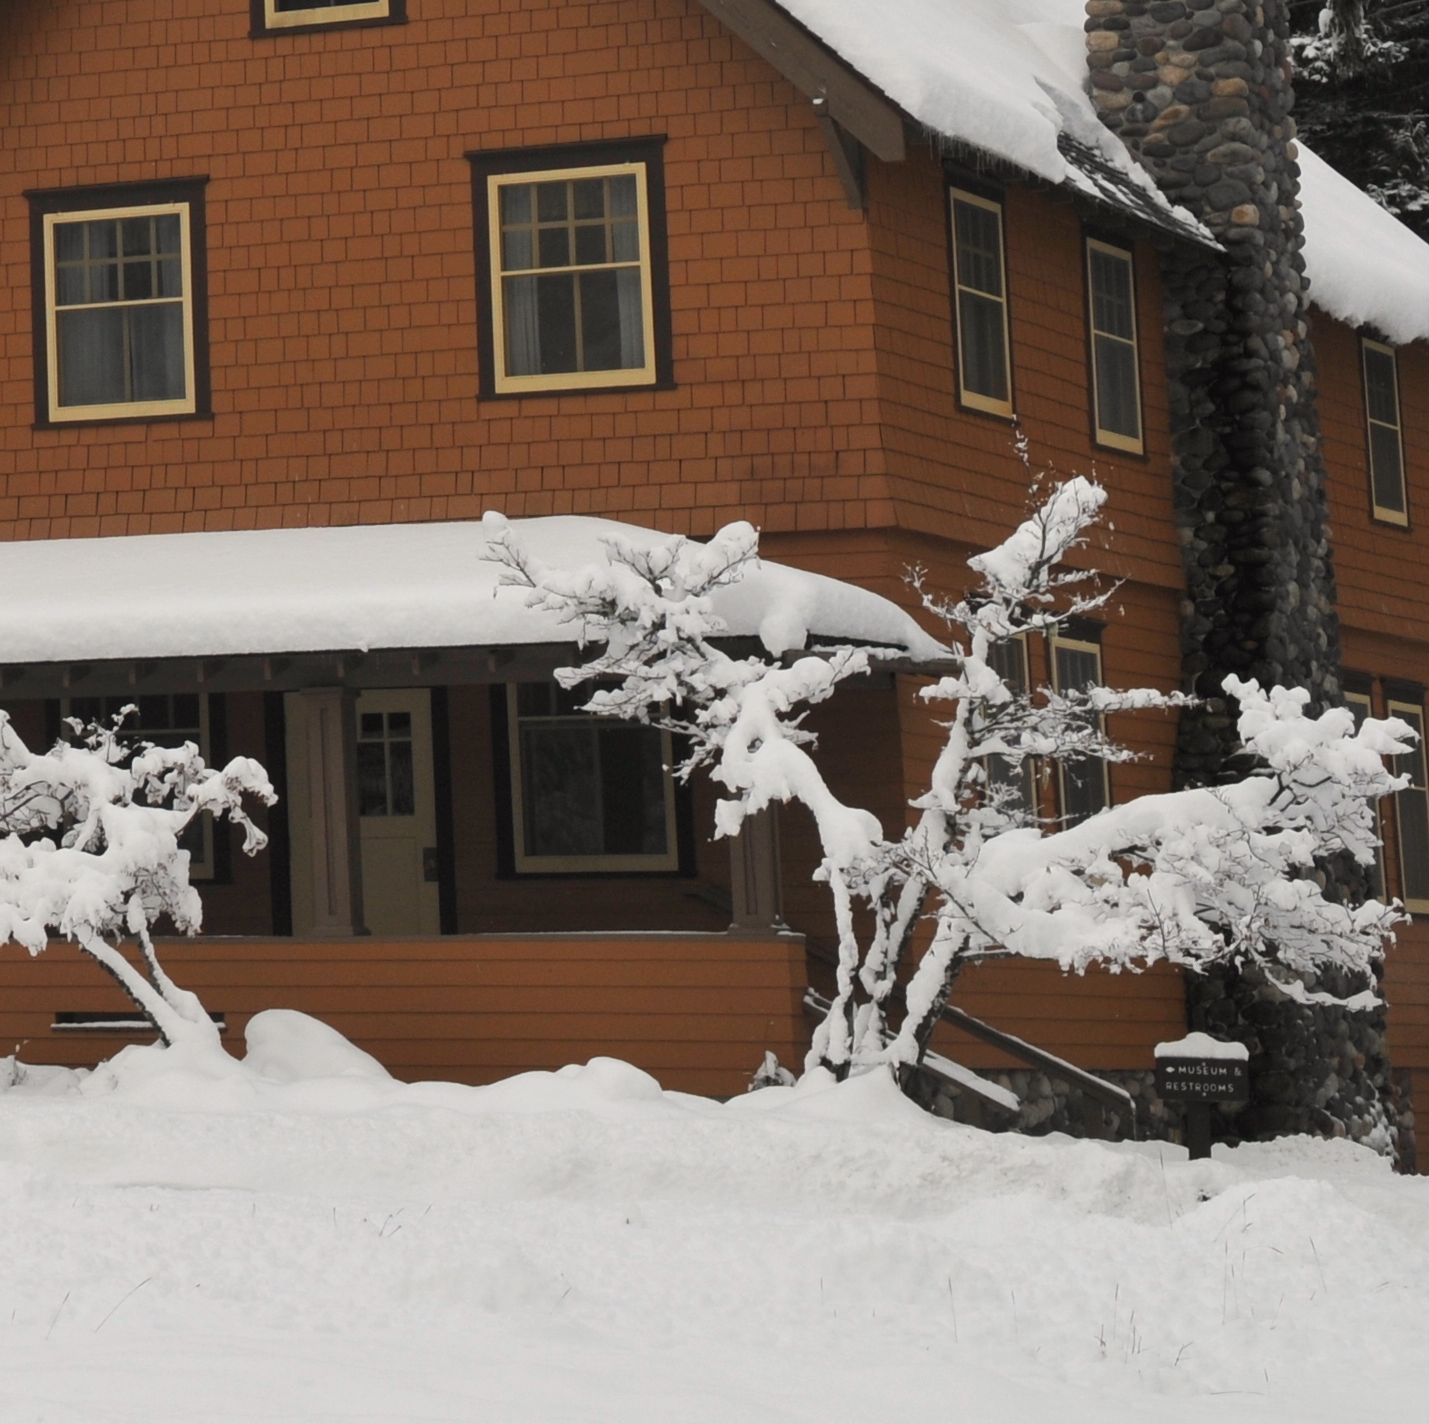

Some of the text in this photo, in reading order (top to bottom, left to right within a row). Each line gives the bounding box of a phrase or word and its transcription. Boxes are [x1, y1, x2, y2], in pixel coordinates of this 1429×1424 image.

[1178, 1065, 1243, 1076] MUSEUM &
[1165, 1081, 1234, 1093] RESTROOMS
